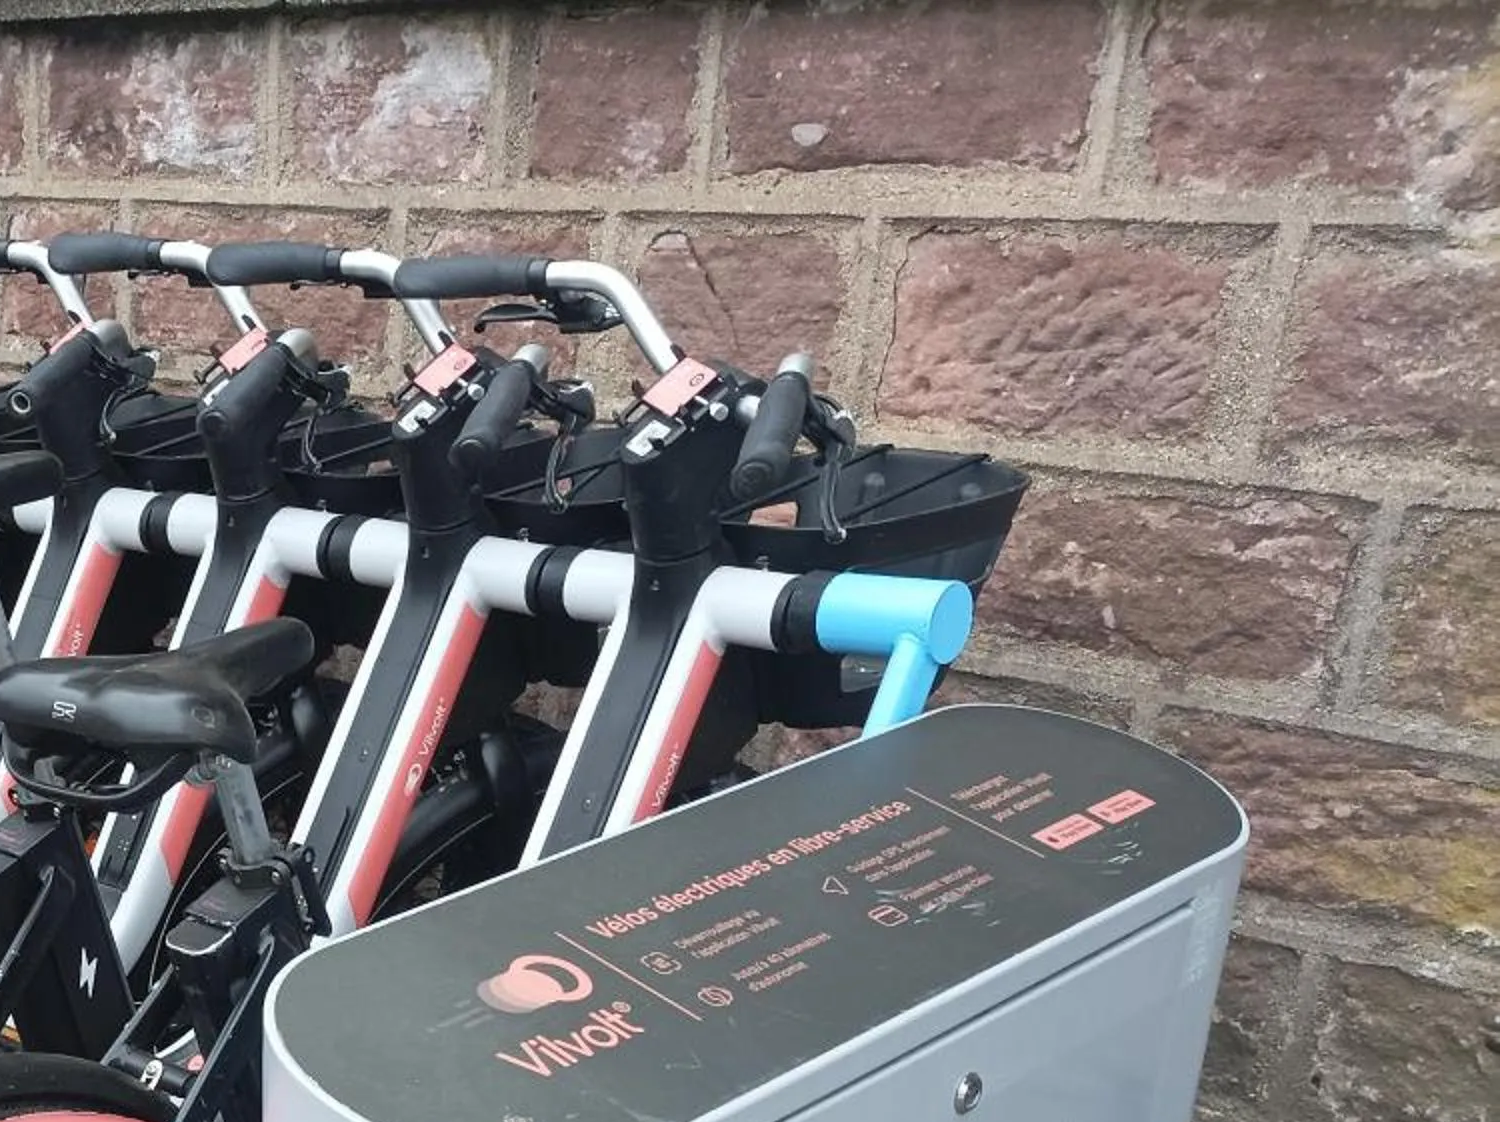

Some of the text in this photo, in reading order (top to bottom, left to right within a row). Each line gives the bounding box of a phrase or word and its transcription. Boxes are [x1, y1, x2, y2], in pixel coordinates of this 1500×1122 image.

[585, 902, 659, 939] Vélos
[651, 857, 772, 913] électriques
[767, 846, 799, 866] en
[788, 799, 912, 857] libre-service
